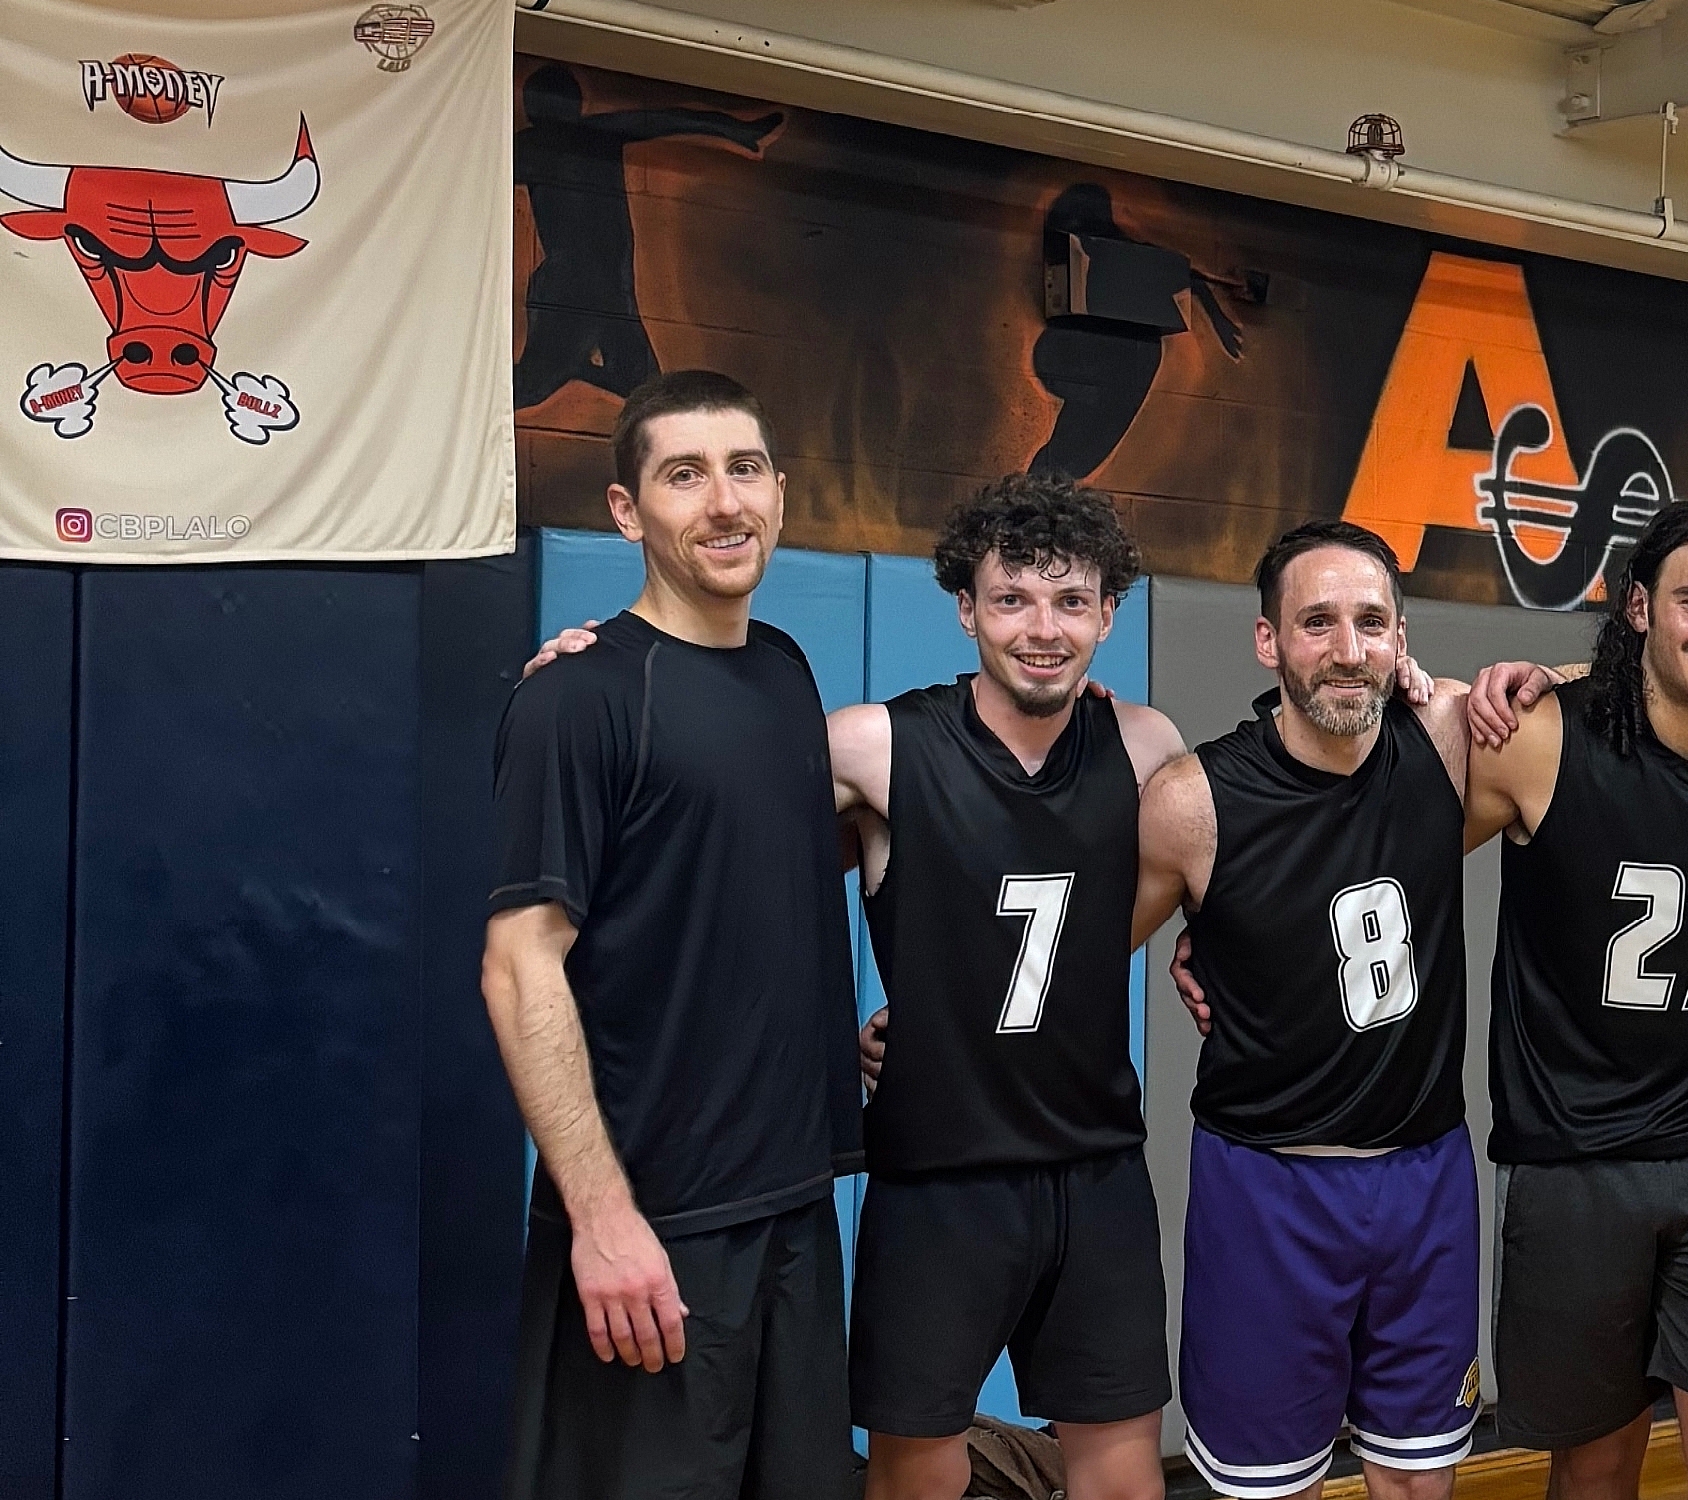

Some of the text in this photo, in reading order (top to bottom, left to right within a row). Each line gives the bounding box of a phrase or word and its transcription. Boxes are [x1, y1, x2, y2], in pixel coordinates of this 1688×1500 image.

[29, 383, 83, 414] A-MONEY
[236, 391, 282, 419] BULLZ
[95, 513, 250, 541] CBPLALO
[995, 871, 1076, 1034] 7
[1328, 876, 1419, 1033] 8
